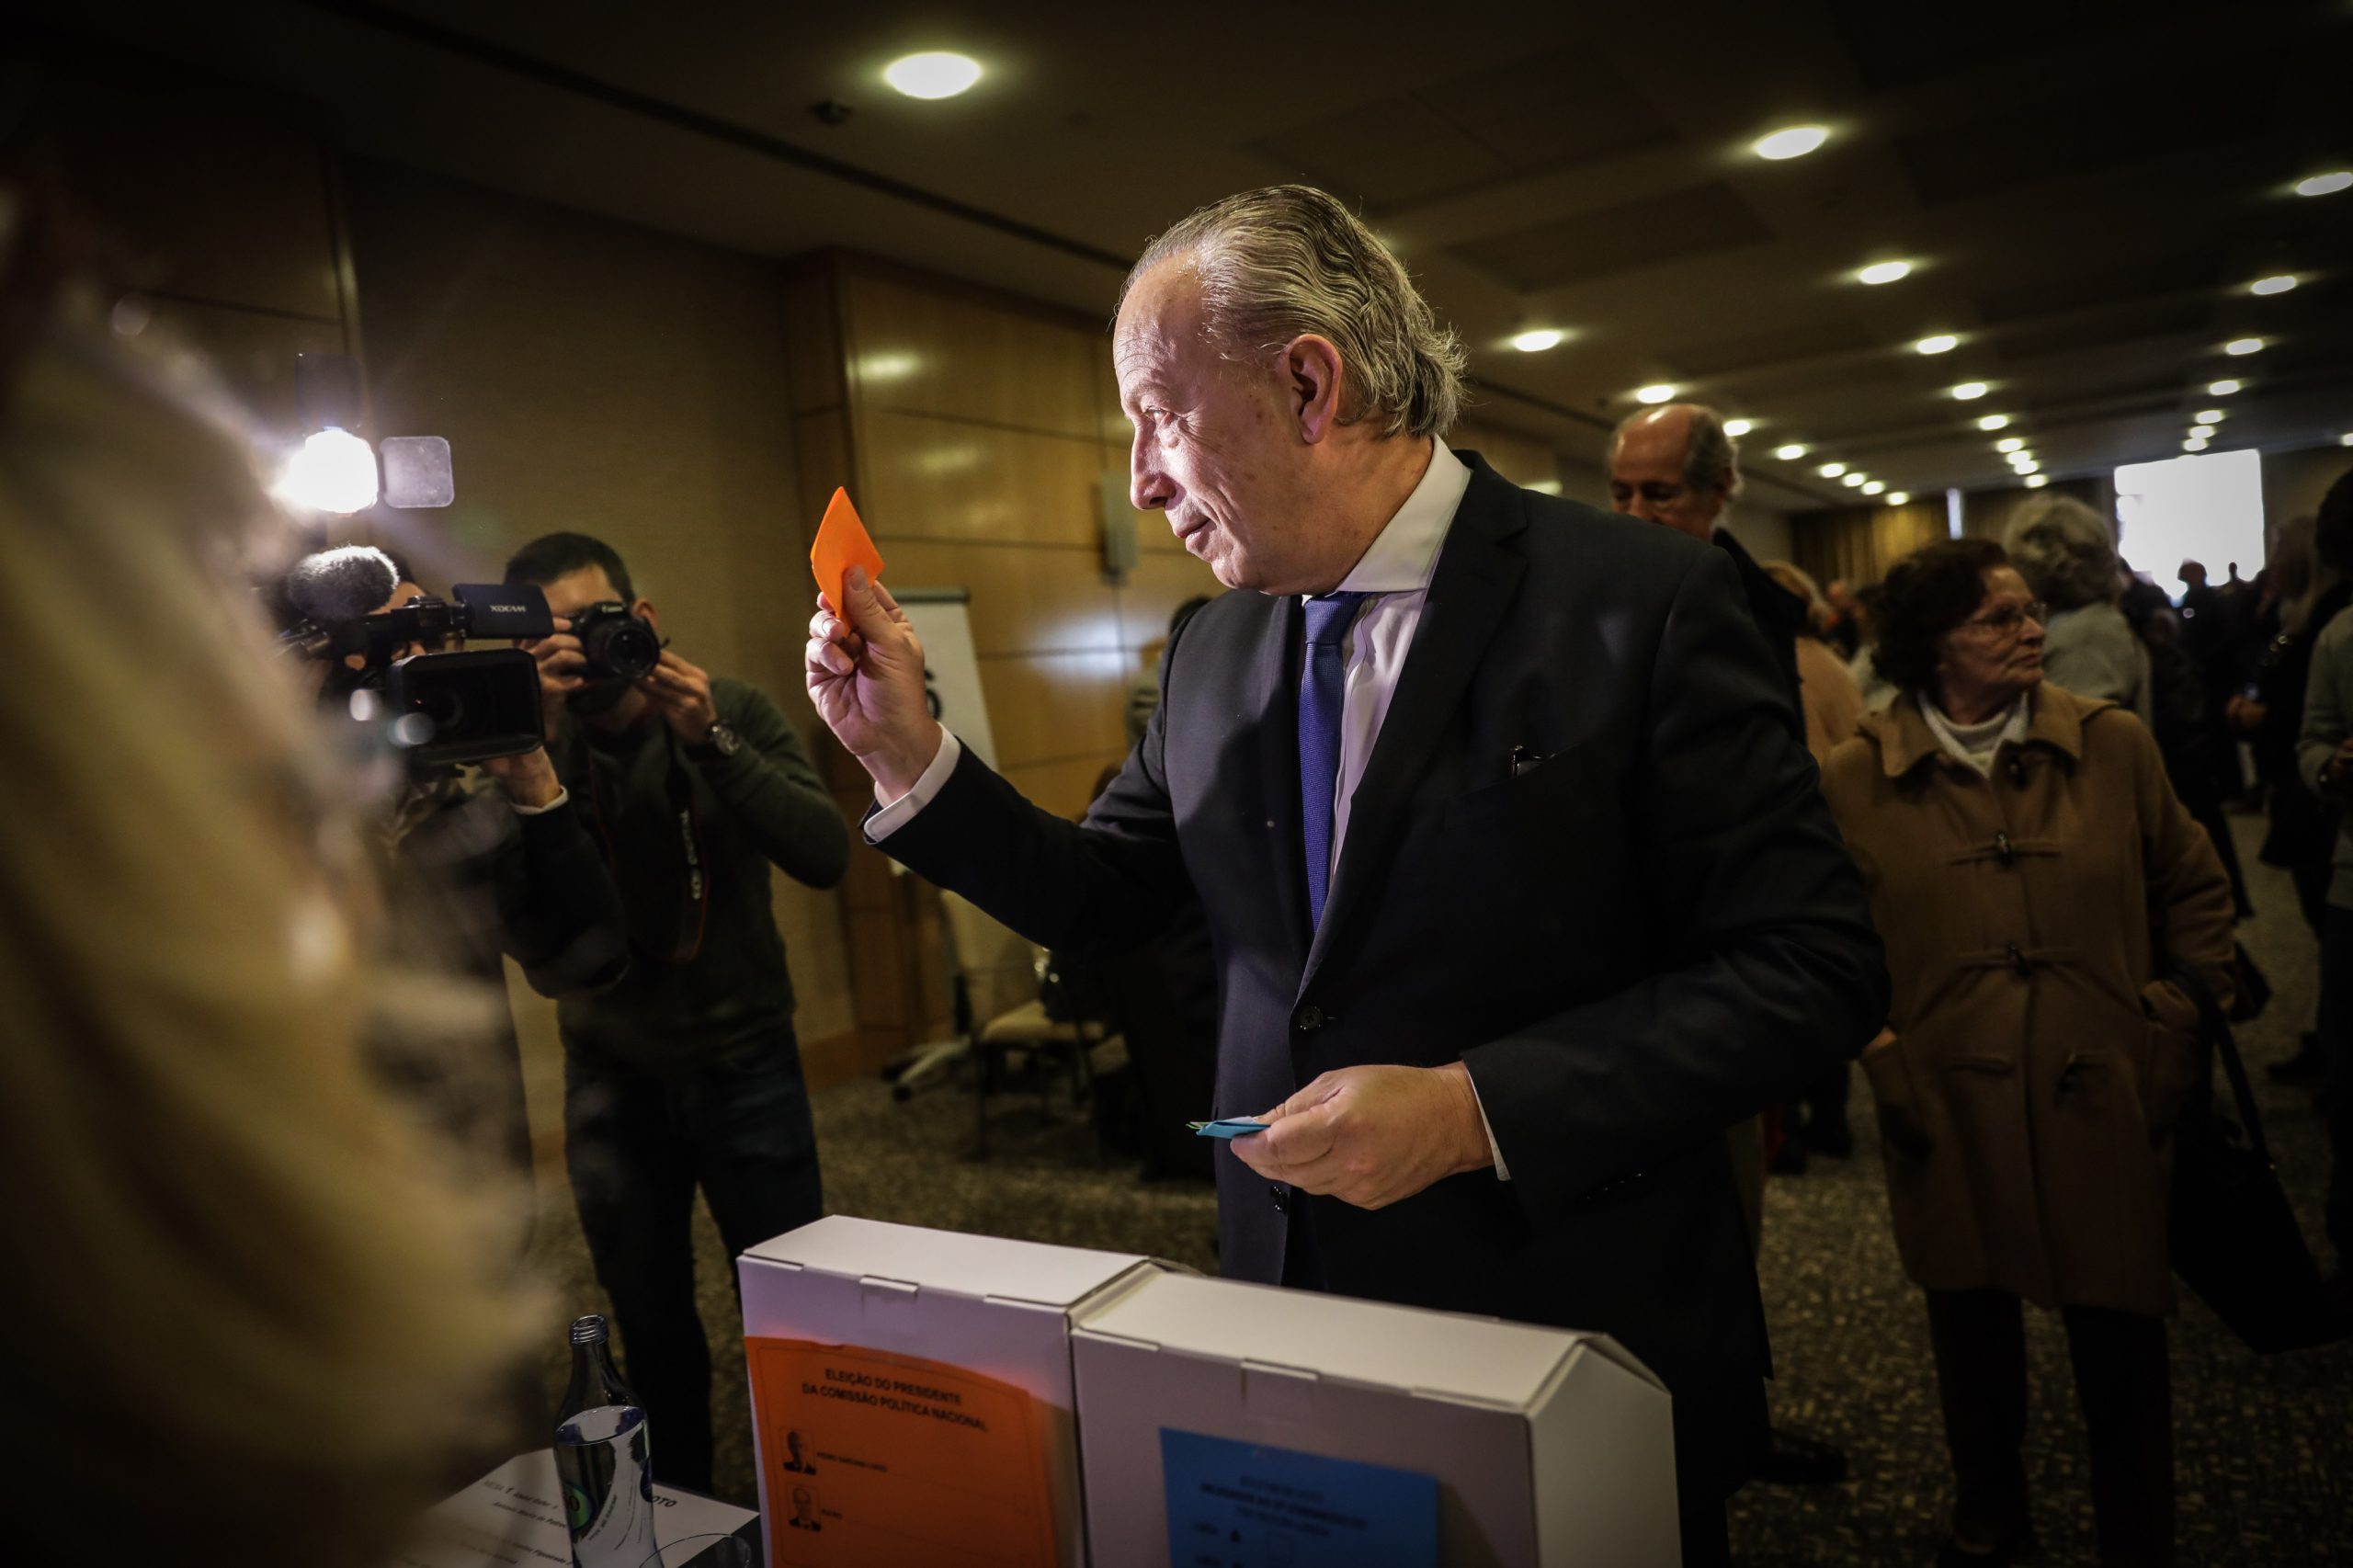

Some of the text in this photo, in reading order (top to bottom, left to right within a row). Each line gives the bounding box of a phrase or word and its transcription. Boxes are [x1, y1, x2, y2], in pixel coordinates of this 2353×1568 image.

[824, 1368, 962, 1406] ELEIÇÃO DO PRESIDENTE
[801, 1382, 989, 1432] DA COMISSÃO POLÍTICA NACIONAL
[652, 1495, 677, 1507] OTO
